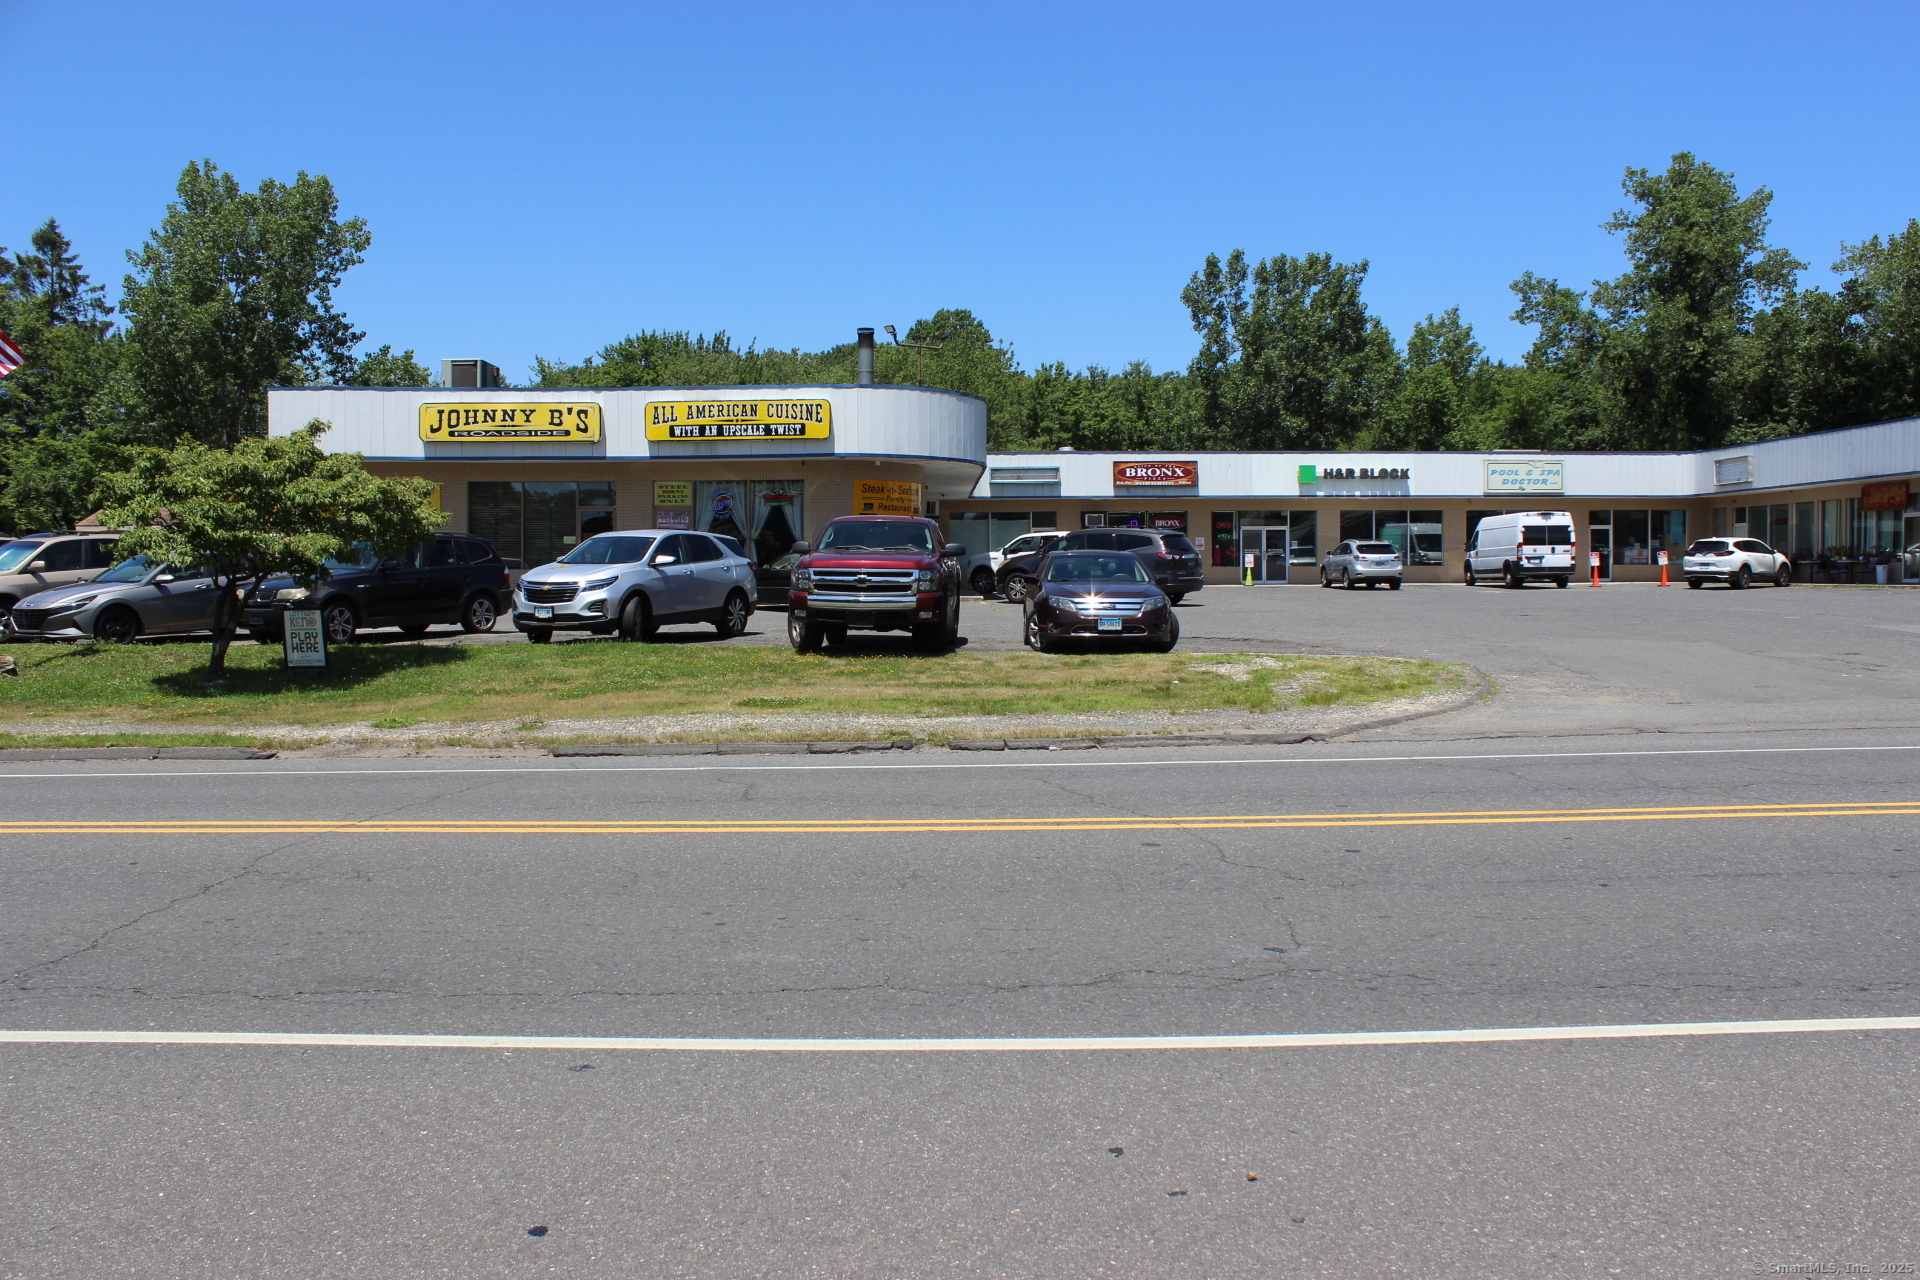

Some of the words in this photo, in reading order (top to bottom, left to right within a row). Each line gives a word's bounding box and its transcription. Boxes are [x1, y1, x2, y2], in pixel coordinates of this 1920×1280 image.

[652, 405, 678, 425] ALL
[686, 403, 759, 420] AMERICAN
[766, 402, 823, 424] CUISINE
[430, 409, 537, 434] JOHNNY
[548, 407, 589, 434] B'S
[673, 425, 700, 437] WITH
[704, 425, 718, 436] AN
[722, 424, 765, 436] UPSCALE
[770, 423, 801, 435] TWIST
[1125, 467, 1185, 477] BRONX
[1323, 468, 1356, 479] H&R
[1359, 468, 1410, 479] BLOCK
[861, 483, 885, 494] Steak
[898, 485, 919, 497] Seafood
[886, 495, 906, 504] Family
[877, 502, 912, 512] Restaurant
[1155, 519, 1180, 527] BRONX
[289, 616, 317, 628] KENO
[290, 631, 318, 642] PLAY
[291, 641, 320, 653] HERE
